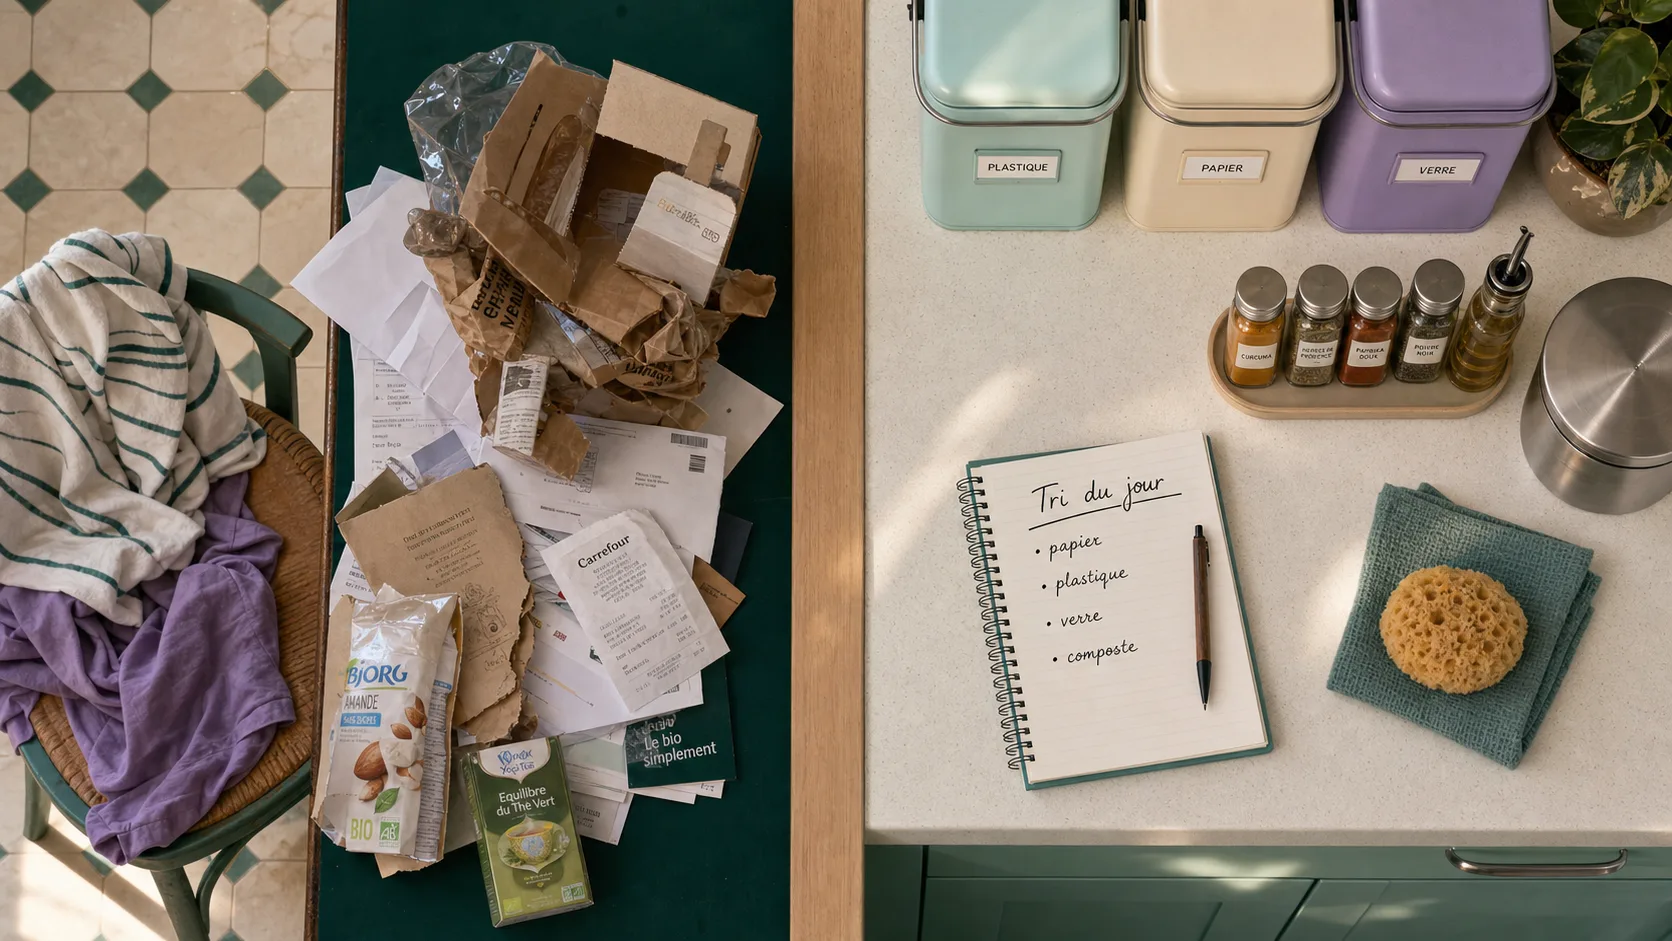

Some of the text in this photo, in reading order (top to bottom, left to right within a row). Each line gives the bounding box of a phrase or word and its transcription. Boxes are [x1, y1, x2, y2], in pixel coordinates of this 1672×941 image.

[987, 163, 1048, 172] PLASTIQUE
[1201, 164, 1243, 173] PAPIER
[1420, 166, 1456, 174] VERRE
[1031, 476, 1164, 513] Tri du jour
[577, 535, 631, 569] Carrefour
[1049, 535, 1102, 561] papier
[1056, 569, 1129, 597] plastique
[1060, 612, 1103, 628] verre
[1067, 640, 1138, 665] composte
[343, 694, 380, 710] AMANDE
[644, 732, 682, 750] Le bio
[643, 741, 717, 767] simplement
[498, 786, 547, 803] Equilibre
[496, 805, 511, 817] du
[532, 796, 556, 809] Vert
[350, 818, 373, 840] BIO
